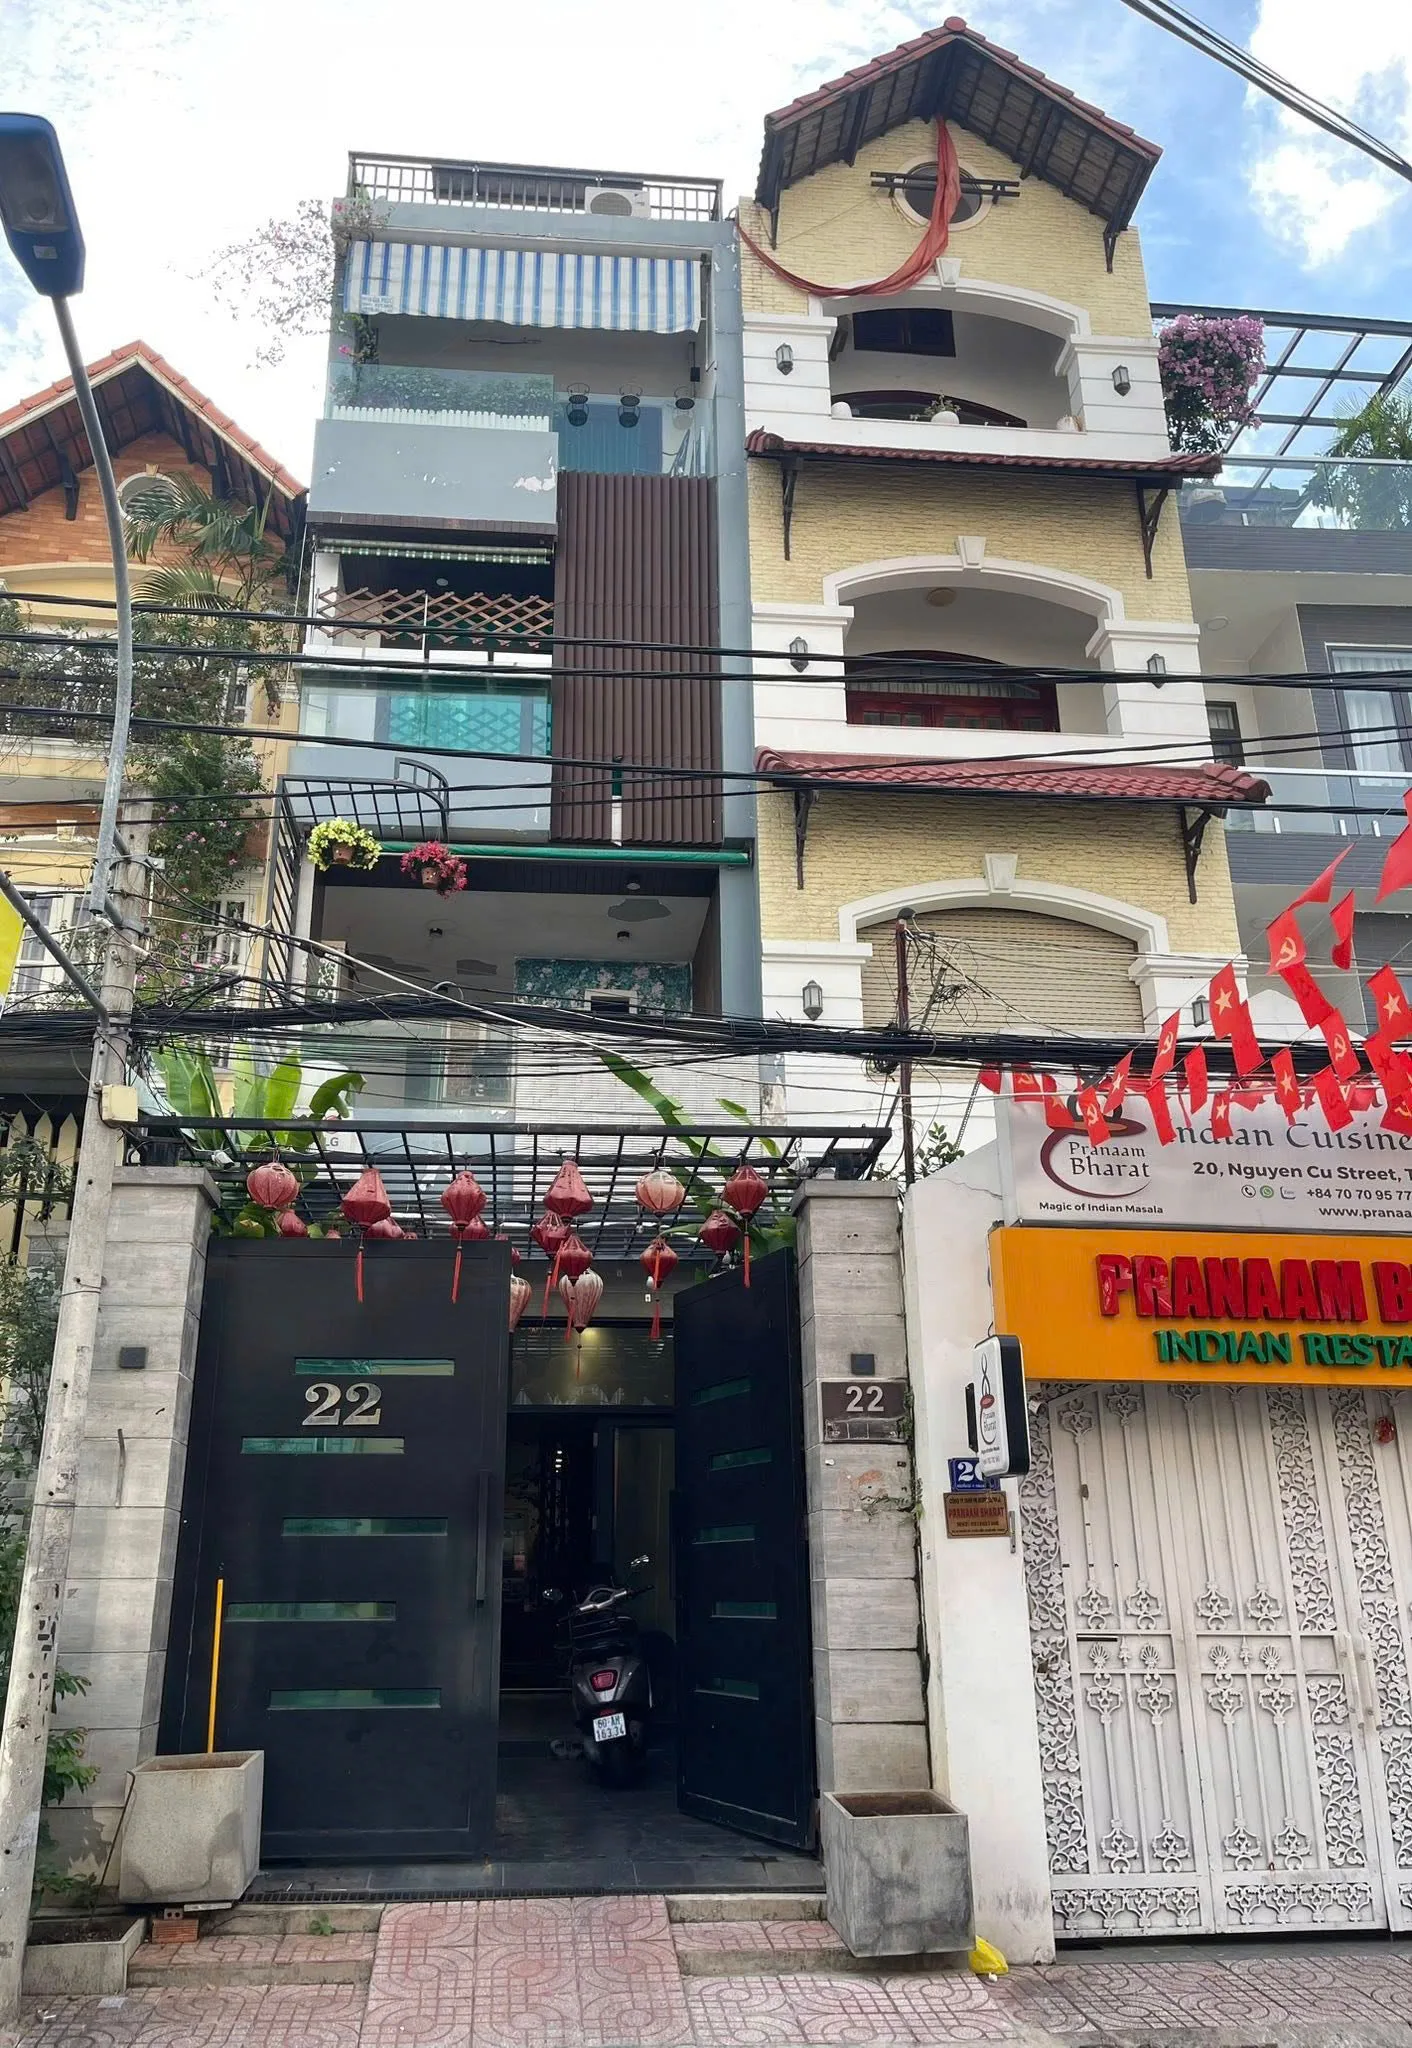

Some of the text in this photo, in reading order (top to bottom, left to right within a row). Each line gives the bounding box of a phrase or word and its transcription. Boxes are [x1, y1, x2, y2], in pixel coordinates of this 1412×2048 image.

[1068, 1141, 1146, 1158] Pranaam
[1069, 1155, 1151, 1178] Bharat
[1192, 1161, 1224, 1178] 20,
[1228, 1162, 1303, 1181] Nguyen
[1306, 1165, 1333, 1179] Cu
[1337, 1166, 1402, 1184] Street,
[1306, 1188, 1332, 1199] +84
[1335, 1189, 1352, 1200] 70
[1356, 1189, 1373, 1201] 70
[1375, 1190, 1393, 1201] 95
[1395, 1190, 1412, 1202] 77
[1039, 1202, 1164, 1214] Magic of Indian Masala
[1318, 1206, 1412, 1220] www.pranaa
[1096, 1253, 1412, 1323] PRANAAM B
[1153, 1329, 1293, 1365] INDIAN
[301, 1382, 382, 1426] 22
[845, 1385, 885, 1412] 22
